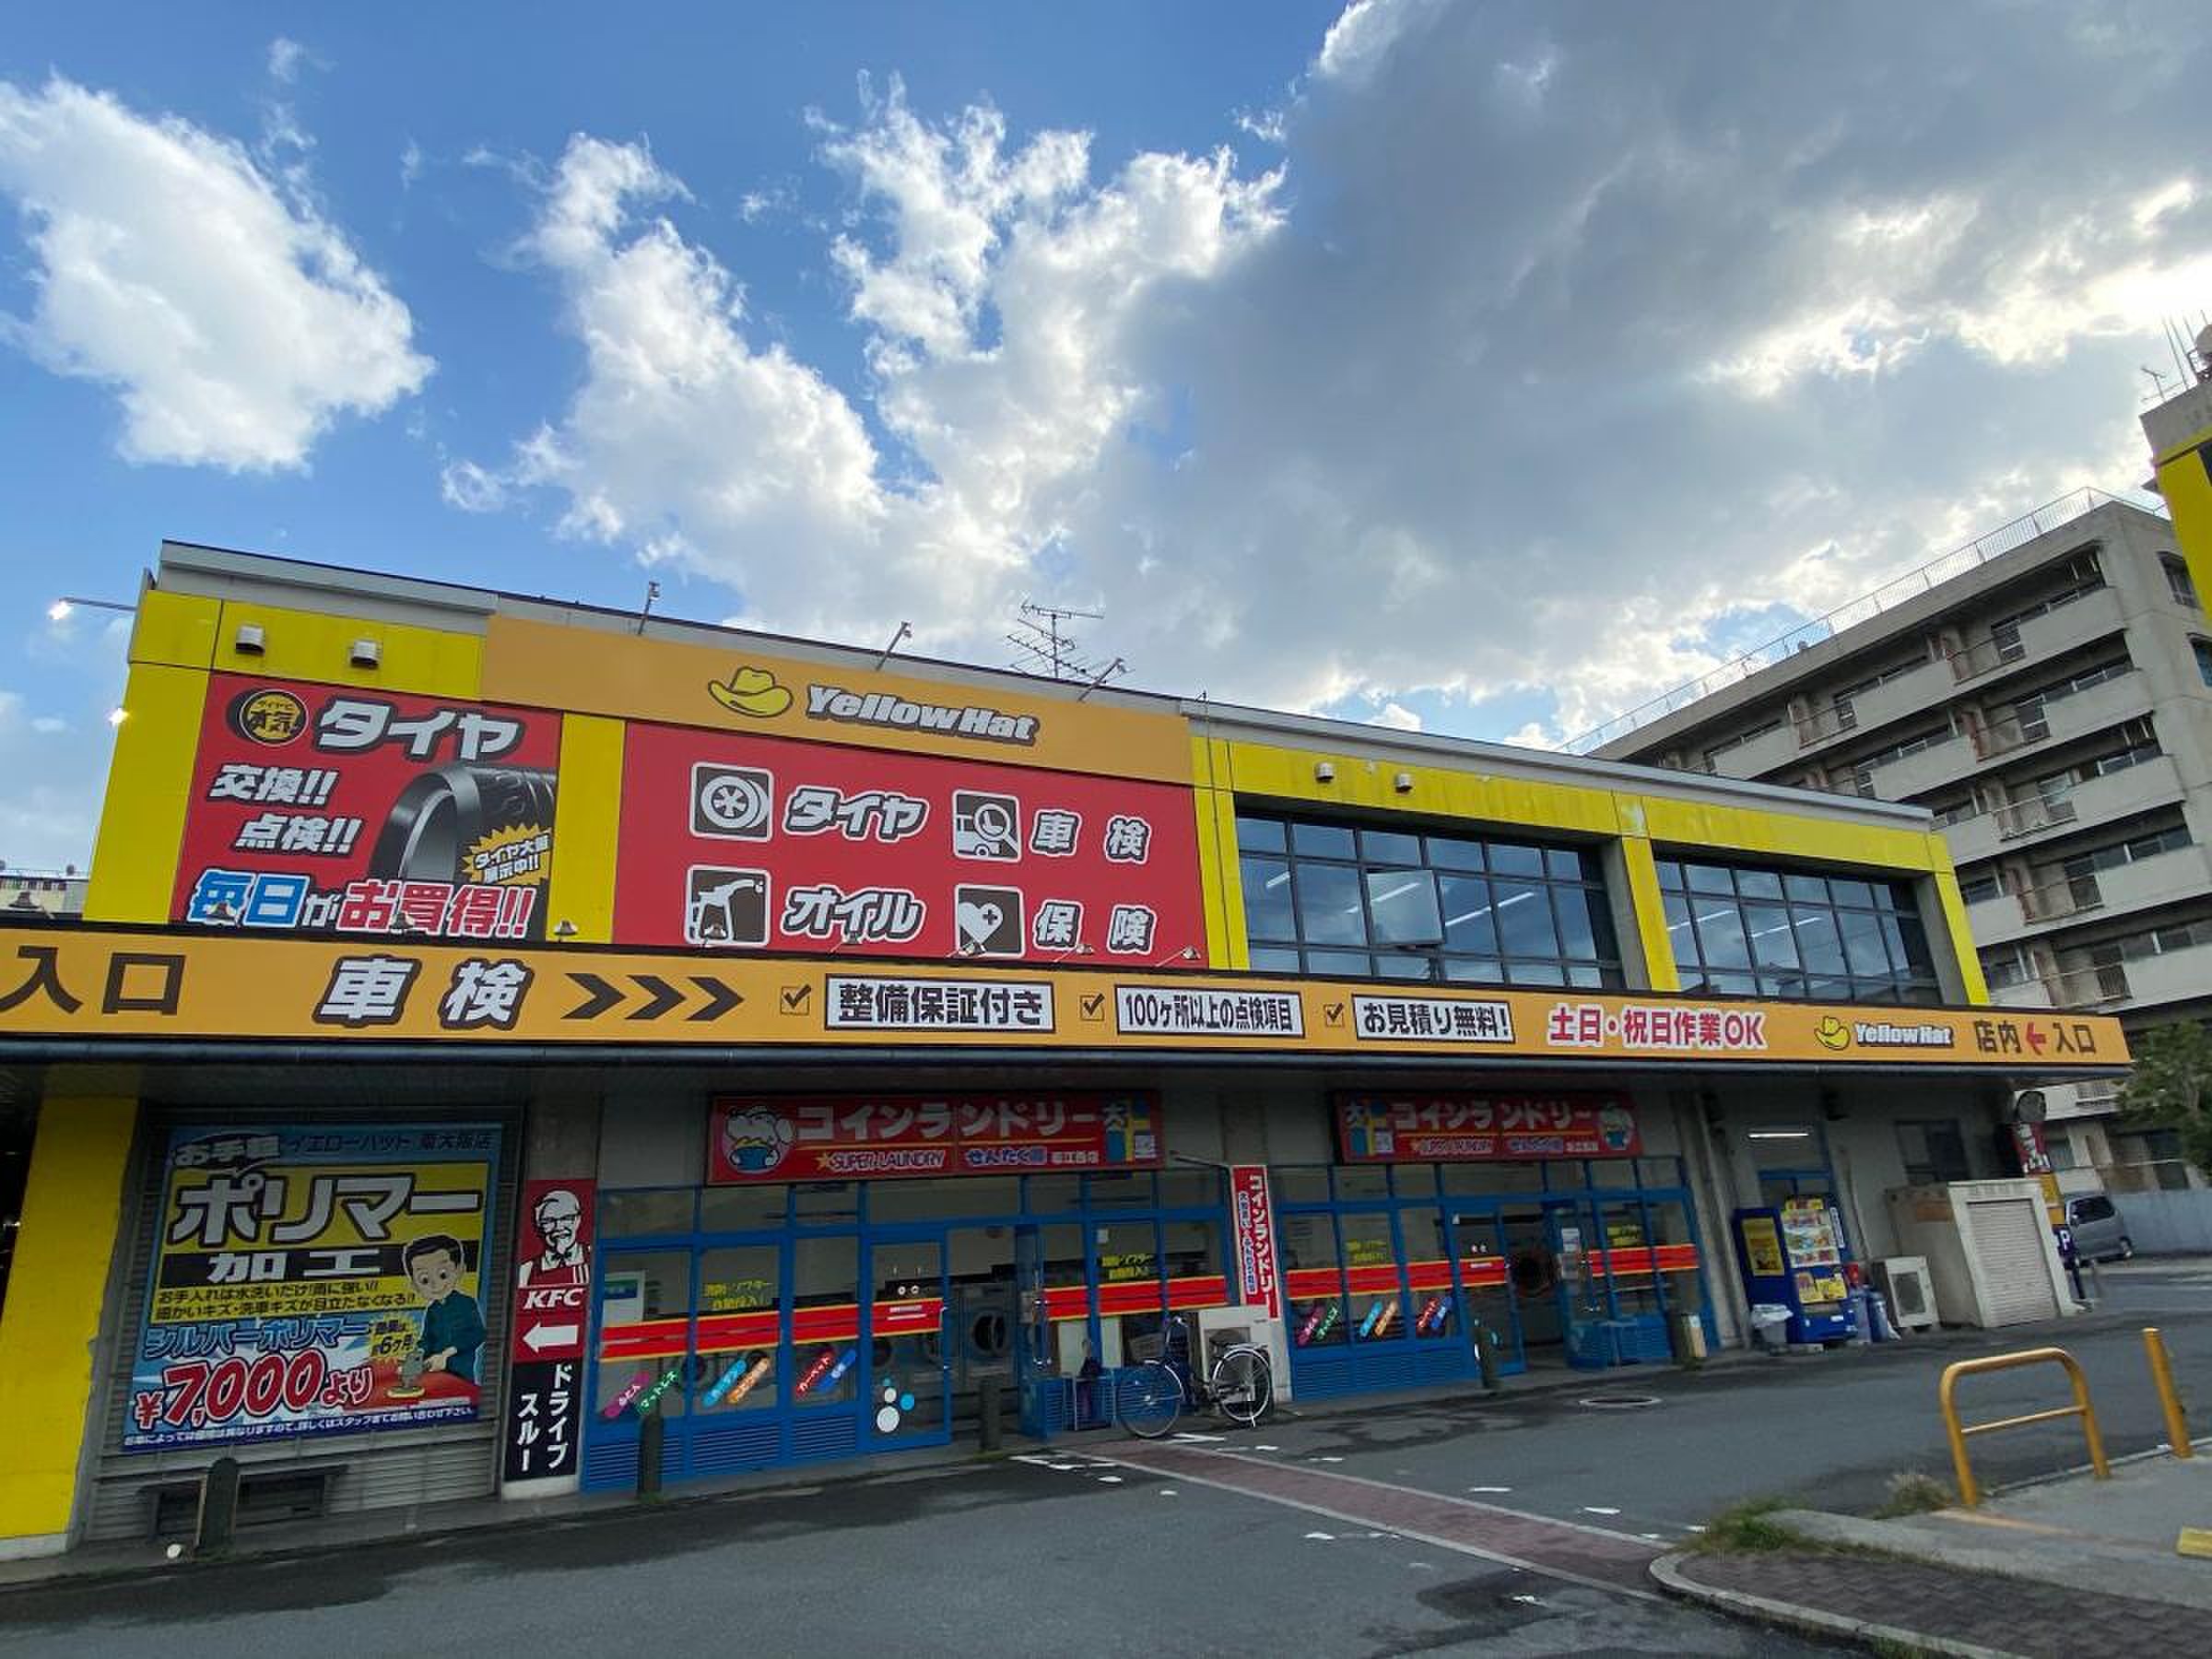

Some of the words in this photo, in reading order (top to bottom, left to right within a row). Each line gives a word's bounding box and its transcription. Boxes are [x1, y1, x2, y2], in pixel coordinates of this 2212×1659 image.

[318, 700, 520, 760] タイヤ
[783, 786, 927, 839] タイヤ
[1030, 809, 1151, 864] 車検
[782, 885, 926, 942] オイル
[1033, 900, 1156, 955] 保険
[0, 946, 185, 1015] 入口
[313, 956, 534, 1030] 車検
[839, 982, 1043, 1026] 整備保証付き
[2053, 1021, 2097, 1053] 入口
[796, 1101, 1098, 1141] コインランドリー
[1394, 1100, 1593, 1130] コインランドリー
[166, 1172, 480, 1244] ポリマー
[207, 1250, 382, 1283] 加工
[524, 1288, 583, 1311] KFC
[517, 1393, 539, 1472] スルー
